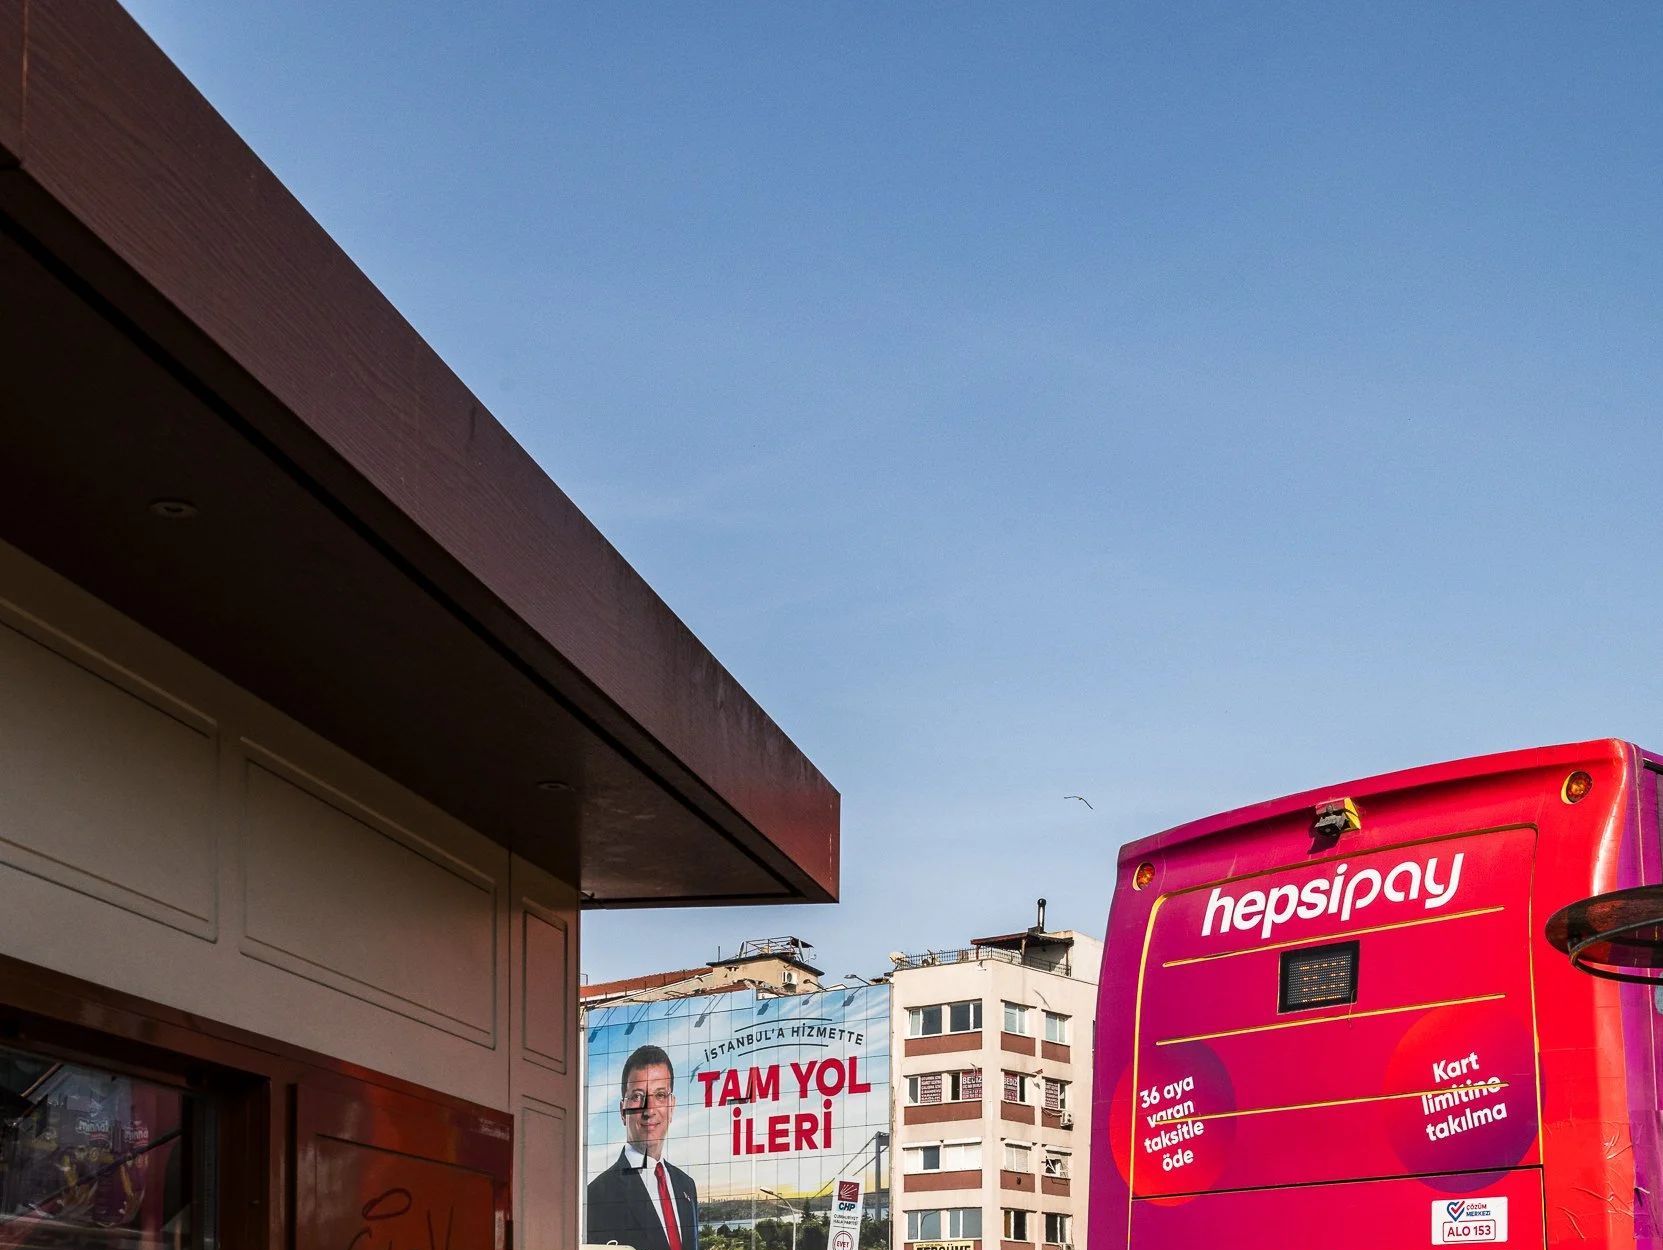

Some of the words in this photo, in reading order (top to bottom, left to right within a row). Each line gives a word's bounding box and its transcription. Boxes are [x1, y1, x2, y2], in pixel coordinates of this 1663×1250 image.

[1201, 853, 1464, 939] hepsipay
[791, 1023, 864, 1046] HİZMETTE
[697, 1064, 780, 1108] TAM
[790, 1056, 871, 1099] YOL
[1432, 1051, 1480, 1083] Kart
[1139, 1086, 1160, 1108] 36
[1163, 1076, 1194, 1100] aya
[1421, 1076, 1501, 1116] limitine
[732, 1098, 833, 1156] İLERİ
[1147, 1100, 1195, 1128] varan
[1425, 1102, 1508, 1142] takılma
[1143, 1119, 1205, 1154] taksitle
[1162, 1148, 1194, 1172] öde
[838, 1202, 856, 1212] CHP
[1466, 1203, 1487, 1211] ÇÖZÜM
[836, 1240, 850, 1248] EVET
[1447, 1226, 1471, 1238] ALO
[1473, 1225, 1491, 1236] 153
